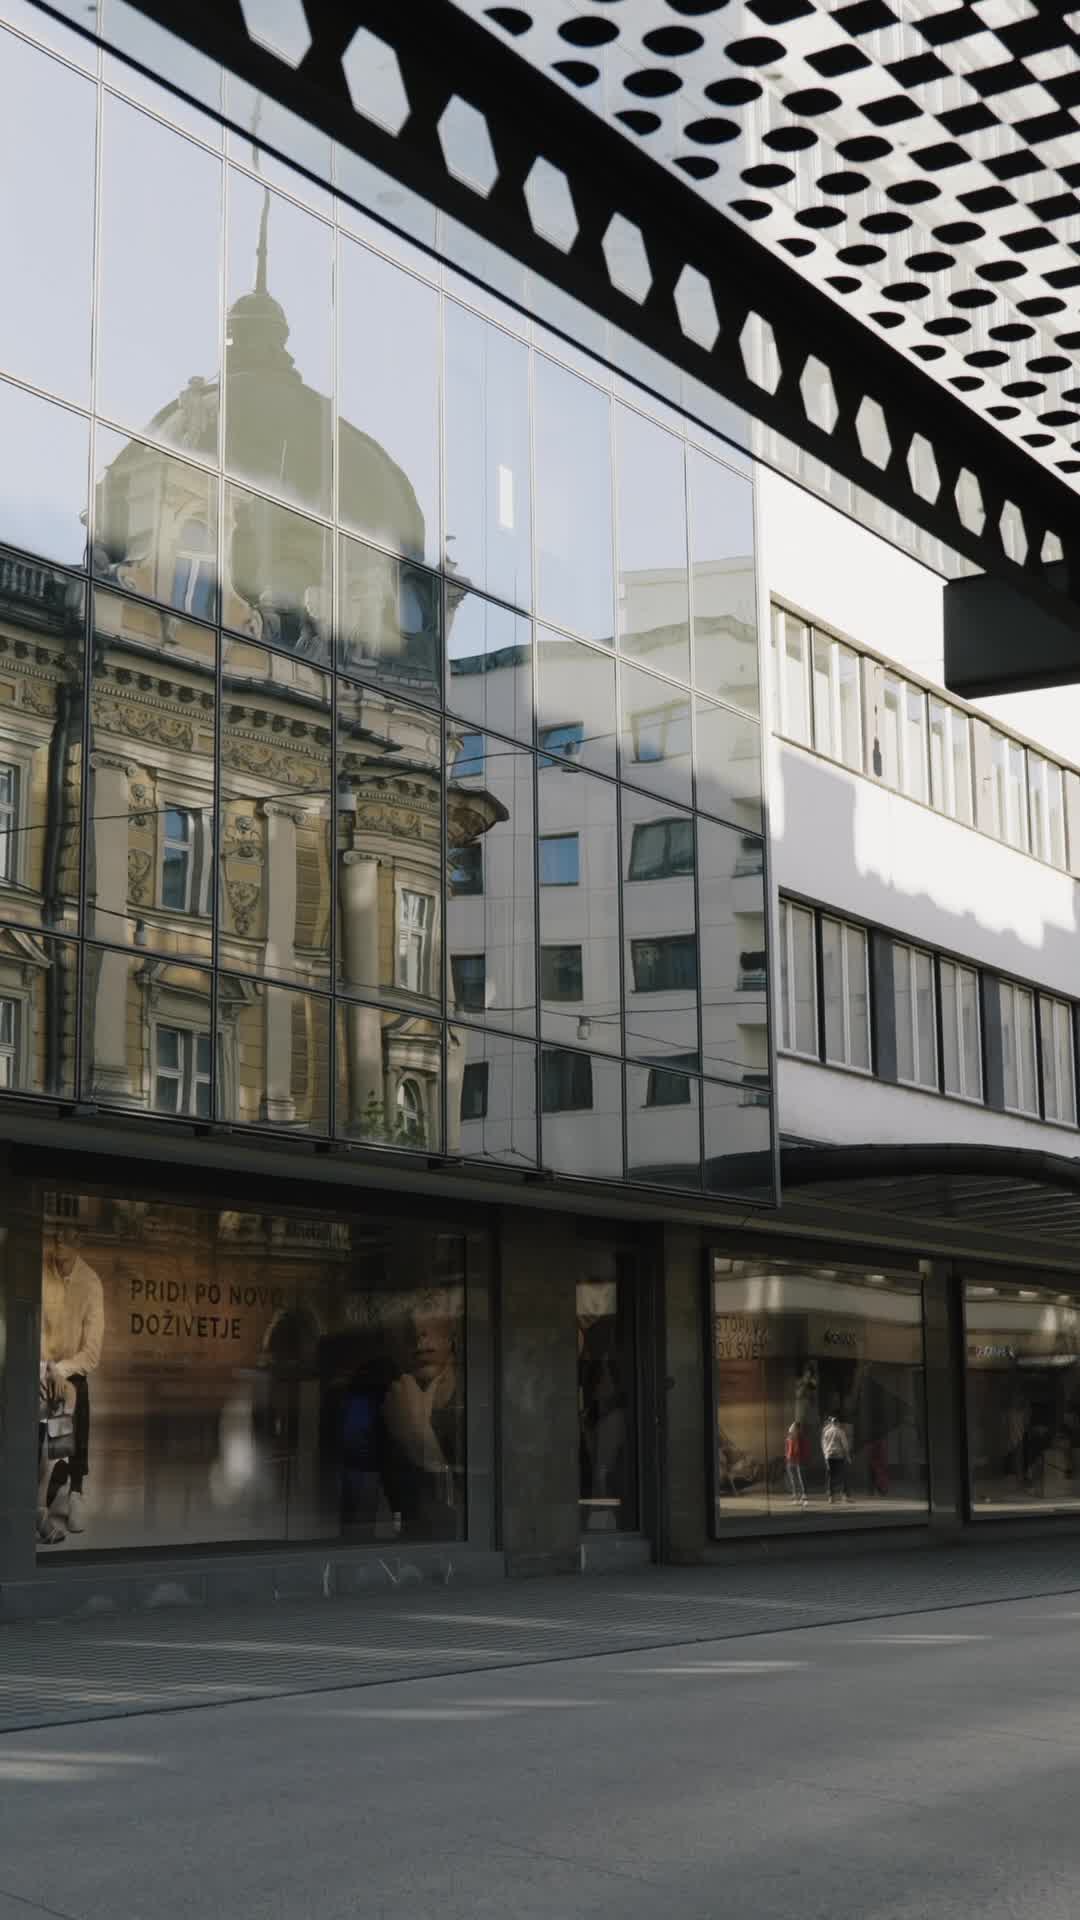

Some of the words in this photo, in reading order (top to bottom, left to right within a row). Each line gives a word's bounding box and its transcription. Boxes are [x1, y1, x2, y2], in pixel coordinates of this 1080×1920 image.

[131, 1279, 187, 1302] PRIDI
[195, 1283, 221, 1304] PO
[131, 1309, 241, 1339] DOŽIVETJE
